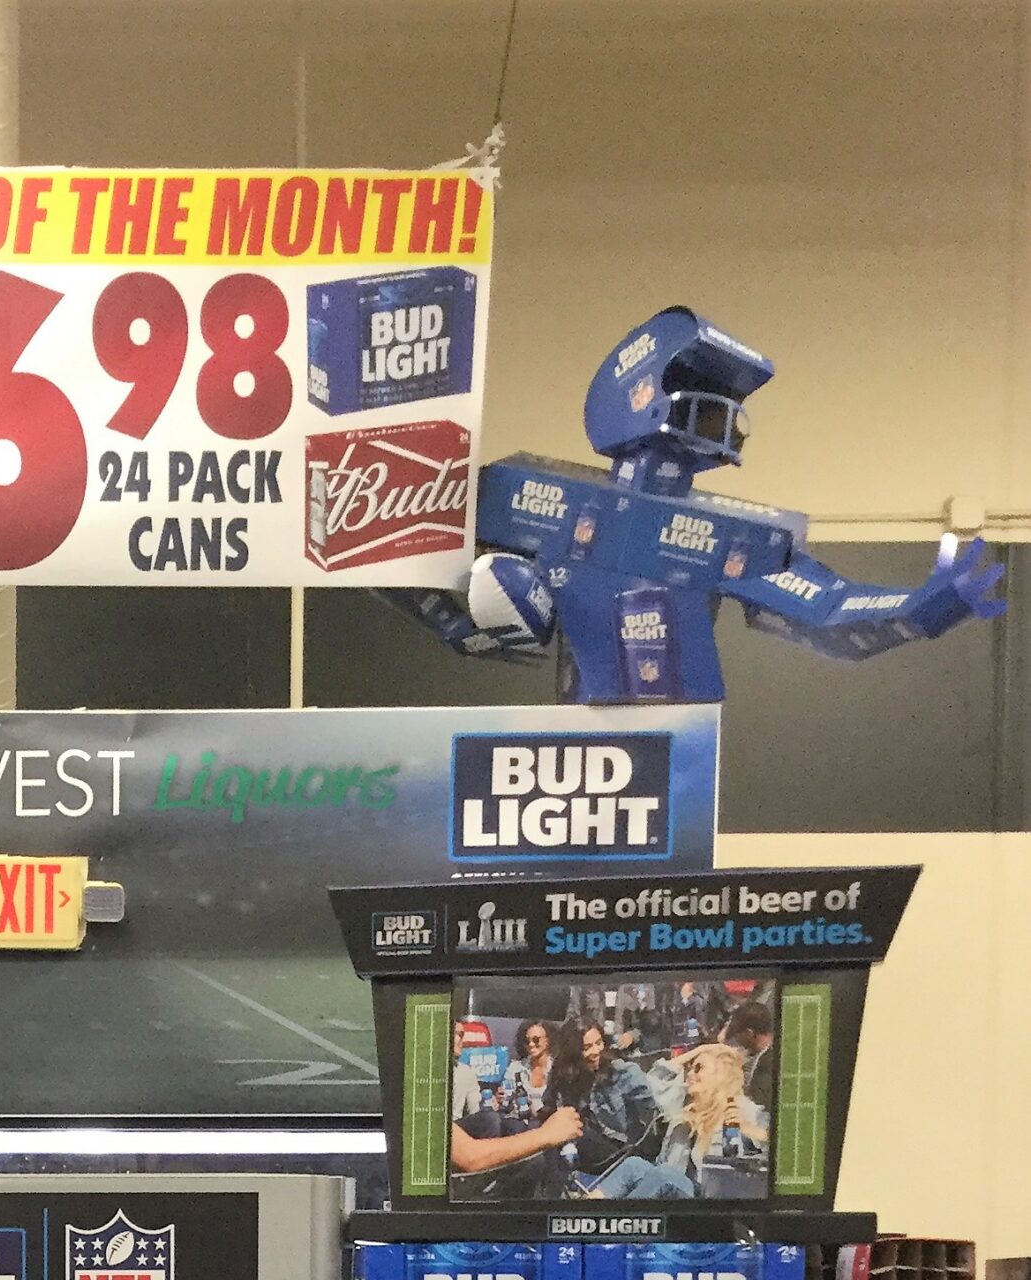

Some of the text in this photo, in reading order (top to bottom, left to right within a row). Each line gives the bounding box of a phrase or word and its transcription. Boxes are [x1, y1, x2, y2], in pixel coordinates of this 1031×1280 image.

[70, 178, 194, 255] THE
[205, 176, 482, 257] MONTH!
[372, 304, 444, 348] BUD
[361, 337, 452, 383] LIGHT
[99, 450, 282, 503] 24 PACK
[522, 480, 564, 501] BUD
[511, 494, 568, 519] LIGHT
[671, 513, 715, 536] BUD
[129, 516, 249, 571] CANS
[660, 527, 718, 554] LIGHT
[154, 751, 399, 823] Liquors
[492, 746, 632, 795] BUD
[462, 798, 659, 846] LIGHT
[546, 881, 860, 921] The official beer of
[376, 929, 433, 946] LIGHT
[383, 915, 424, 931] BUD
[546, 917, 872, 958] Super Bowl parties.
[552, 1219, 661, 1233] BUD LIGHT
